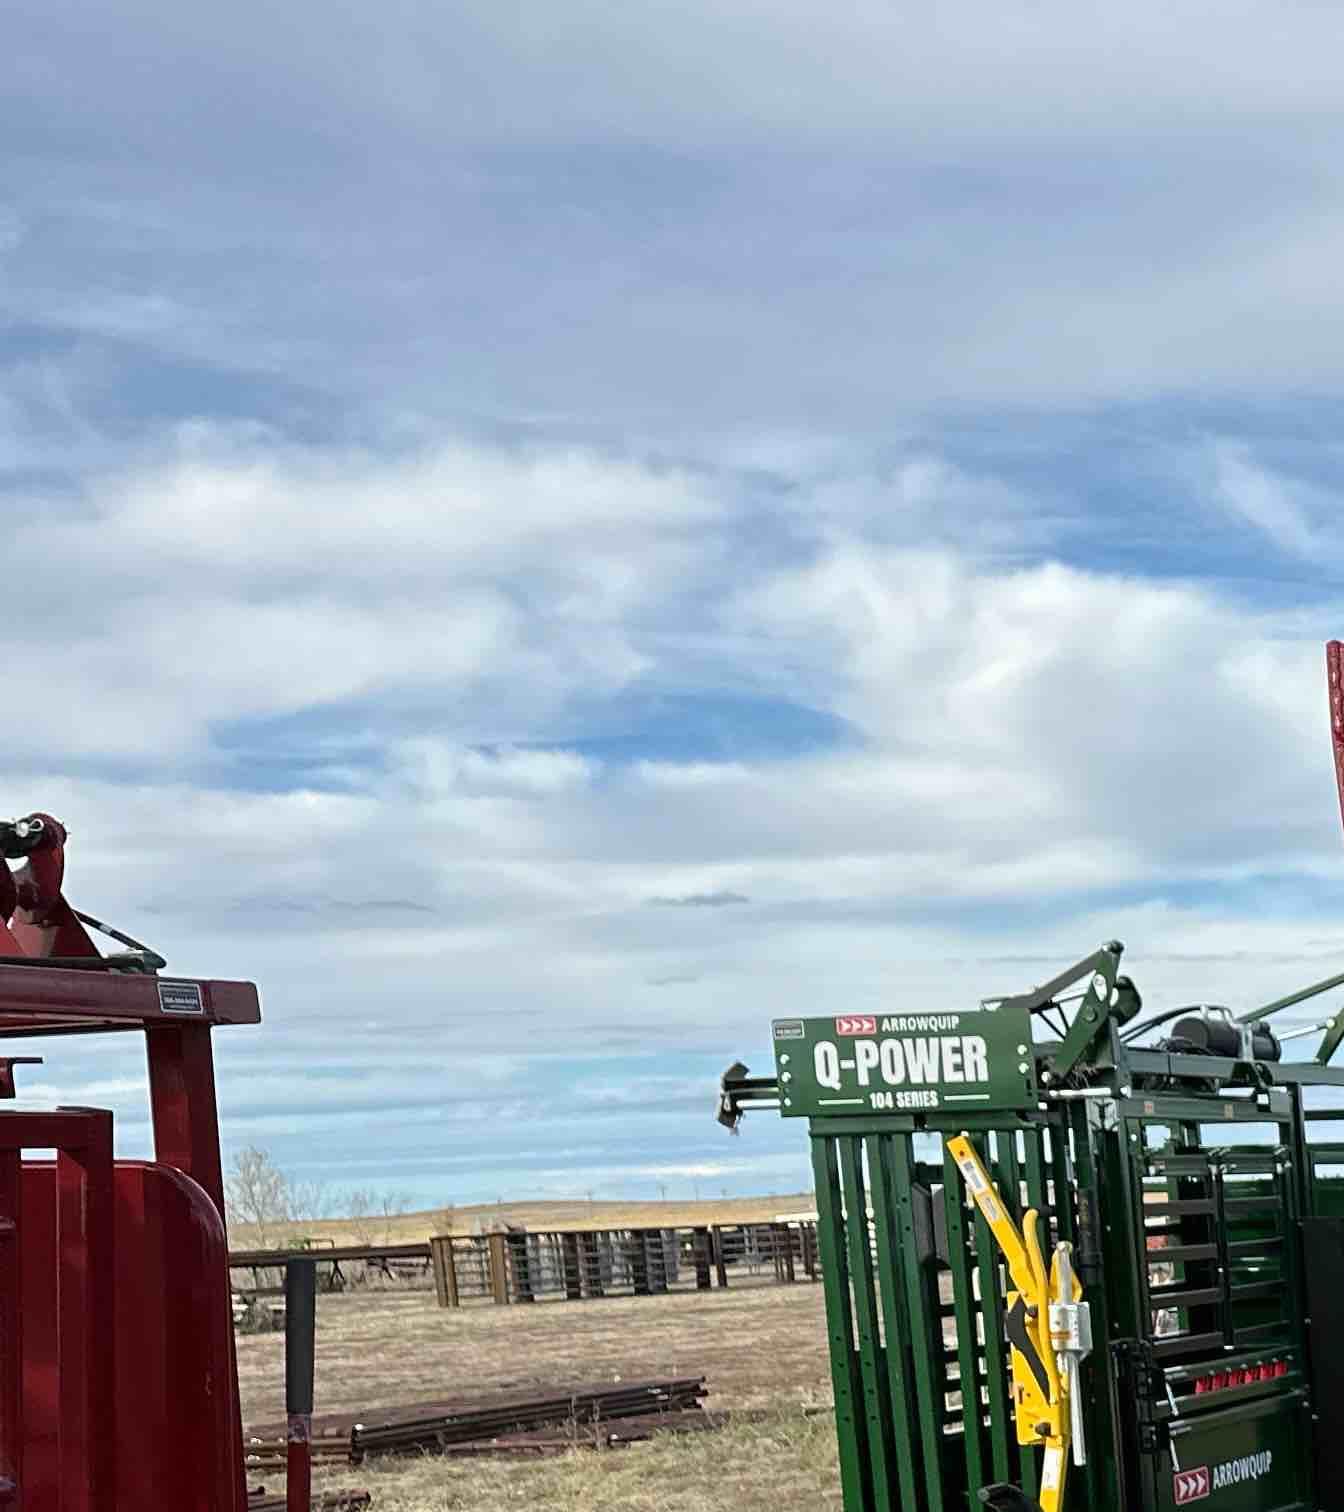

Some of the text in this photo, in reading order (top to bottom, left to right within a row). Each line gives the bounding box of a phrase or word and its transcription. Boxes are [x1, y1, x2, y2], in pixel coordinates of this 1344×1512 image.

[881, 1015, 960, 1033] ARROWQUIP
[813, 1035, 989, 1091] Q-POWER
[869, 1090, 939, 1109] 104 SERIES
[1212, 1450, 1273, 1490] ARROWQUIP
